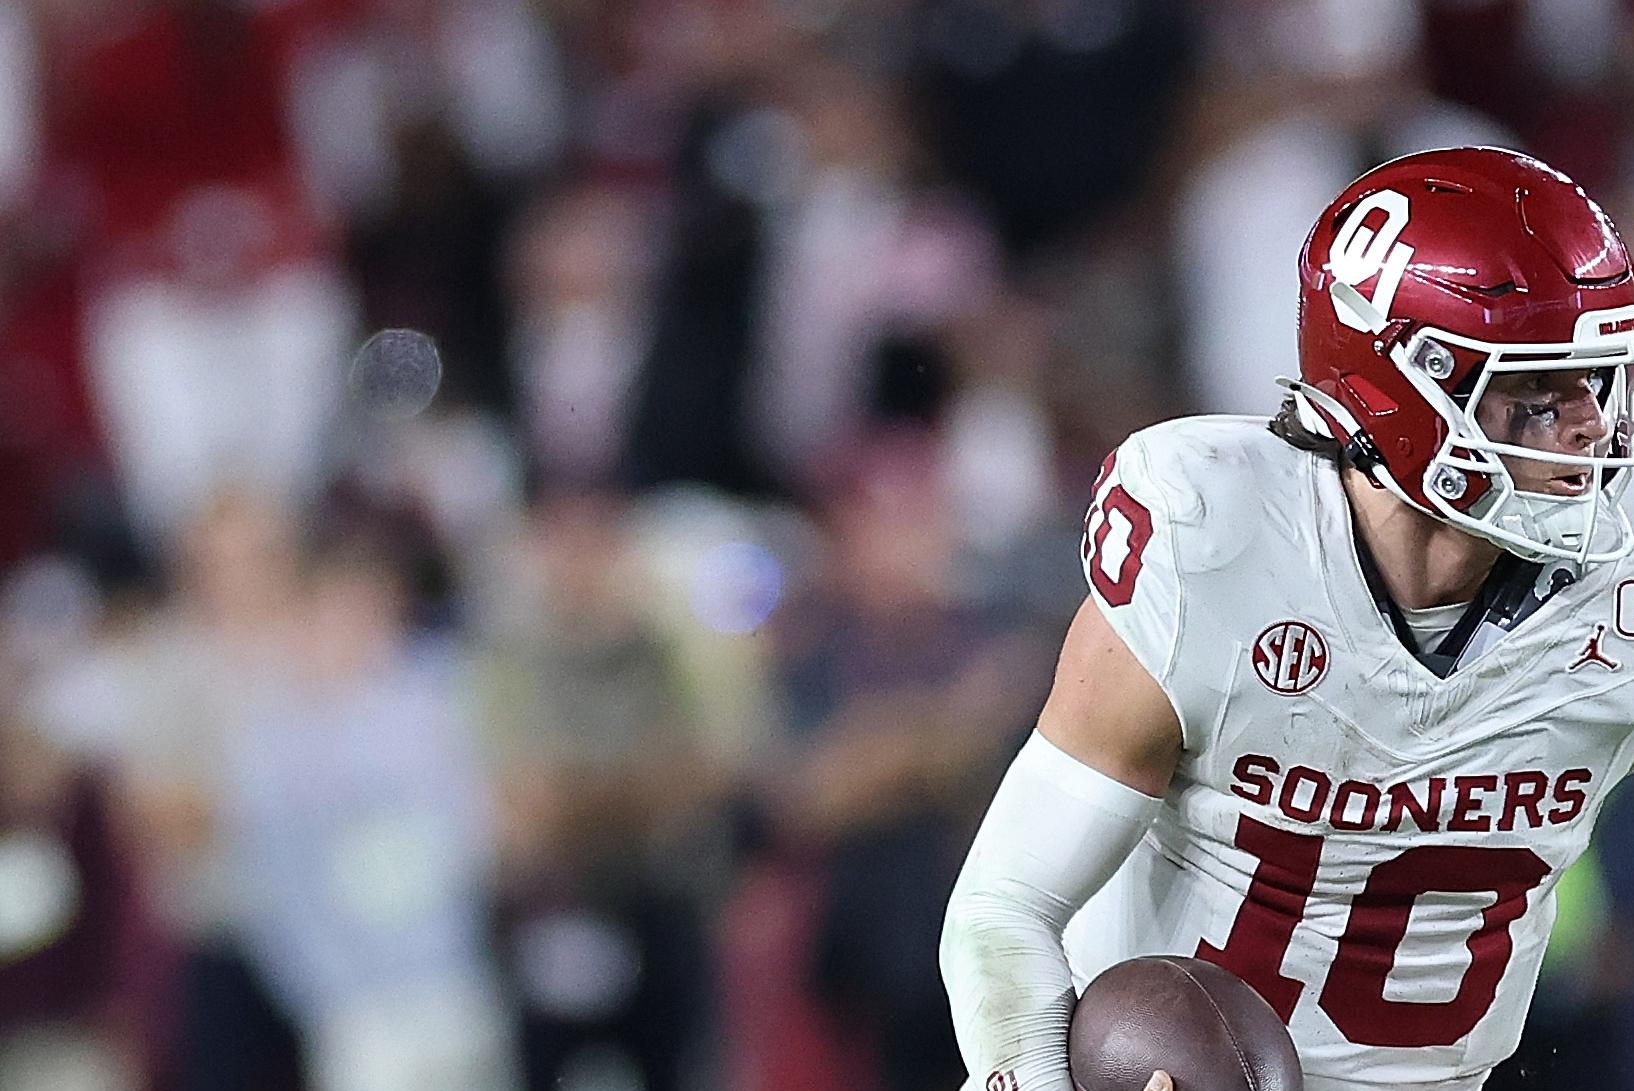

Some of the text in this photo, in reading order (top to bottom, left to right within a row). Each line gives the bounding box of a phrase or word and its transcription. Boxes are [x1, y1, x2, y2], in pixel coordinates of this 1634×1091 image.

[1256, 624, 1323, 690] SEC
[1230, 754, 1592, 832] SOONERS
[1195, 813, 1552, 1047] 10
